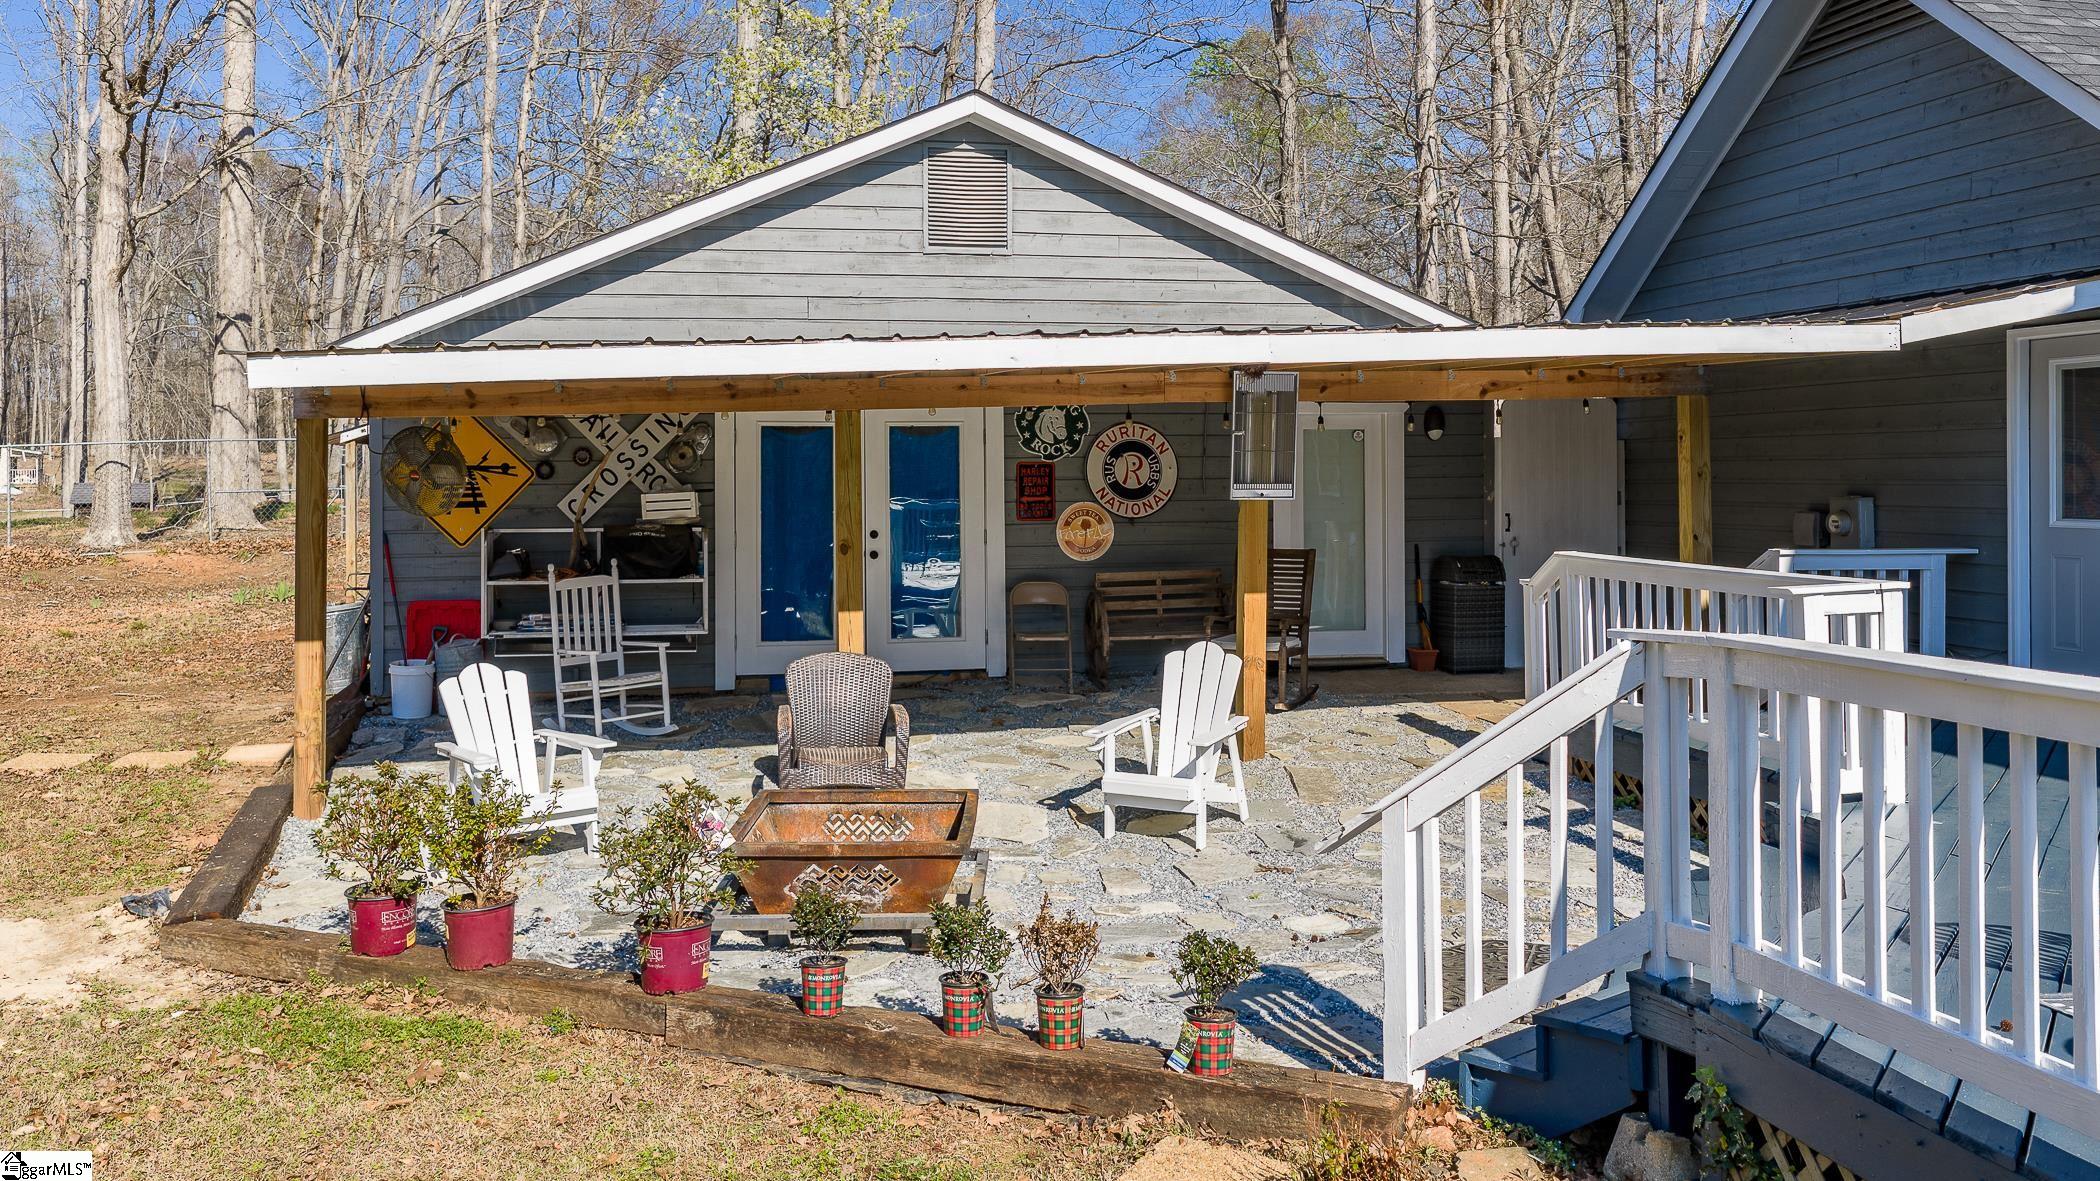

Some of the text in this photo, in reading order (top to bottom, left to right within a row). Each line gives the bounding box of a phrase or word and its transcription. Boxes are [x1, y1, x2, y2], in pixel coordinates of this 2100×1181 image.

[579, 414, 619, 451] AIL
[1030, 438, 1073, 455] ROCK
[1096, 426, 1169, 455] RURITAN
[567, 413, 690, 517] CROSSIN
[1104, 455, 1116, 484] RUS
[1122, 454, 1143, 486] R
[1147, 454, 1160, 488] URBS
[1023, 477, 1050, 486] REPAIR
[1023, 486, 1048, 496] SHOP
[1096, 487, 1171, 515] NATIONAL
[1198, 1030, 1223, 1038] NROVIA
